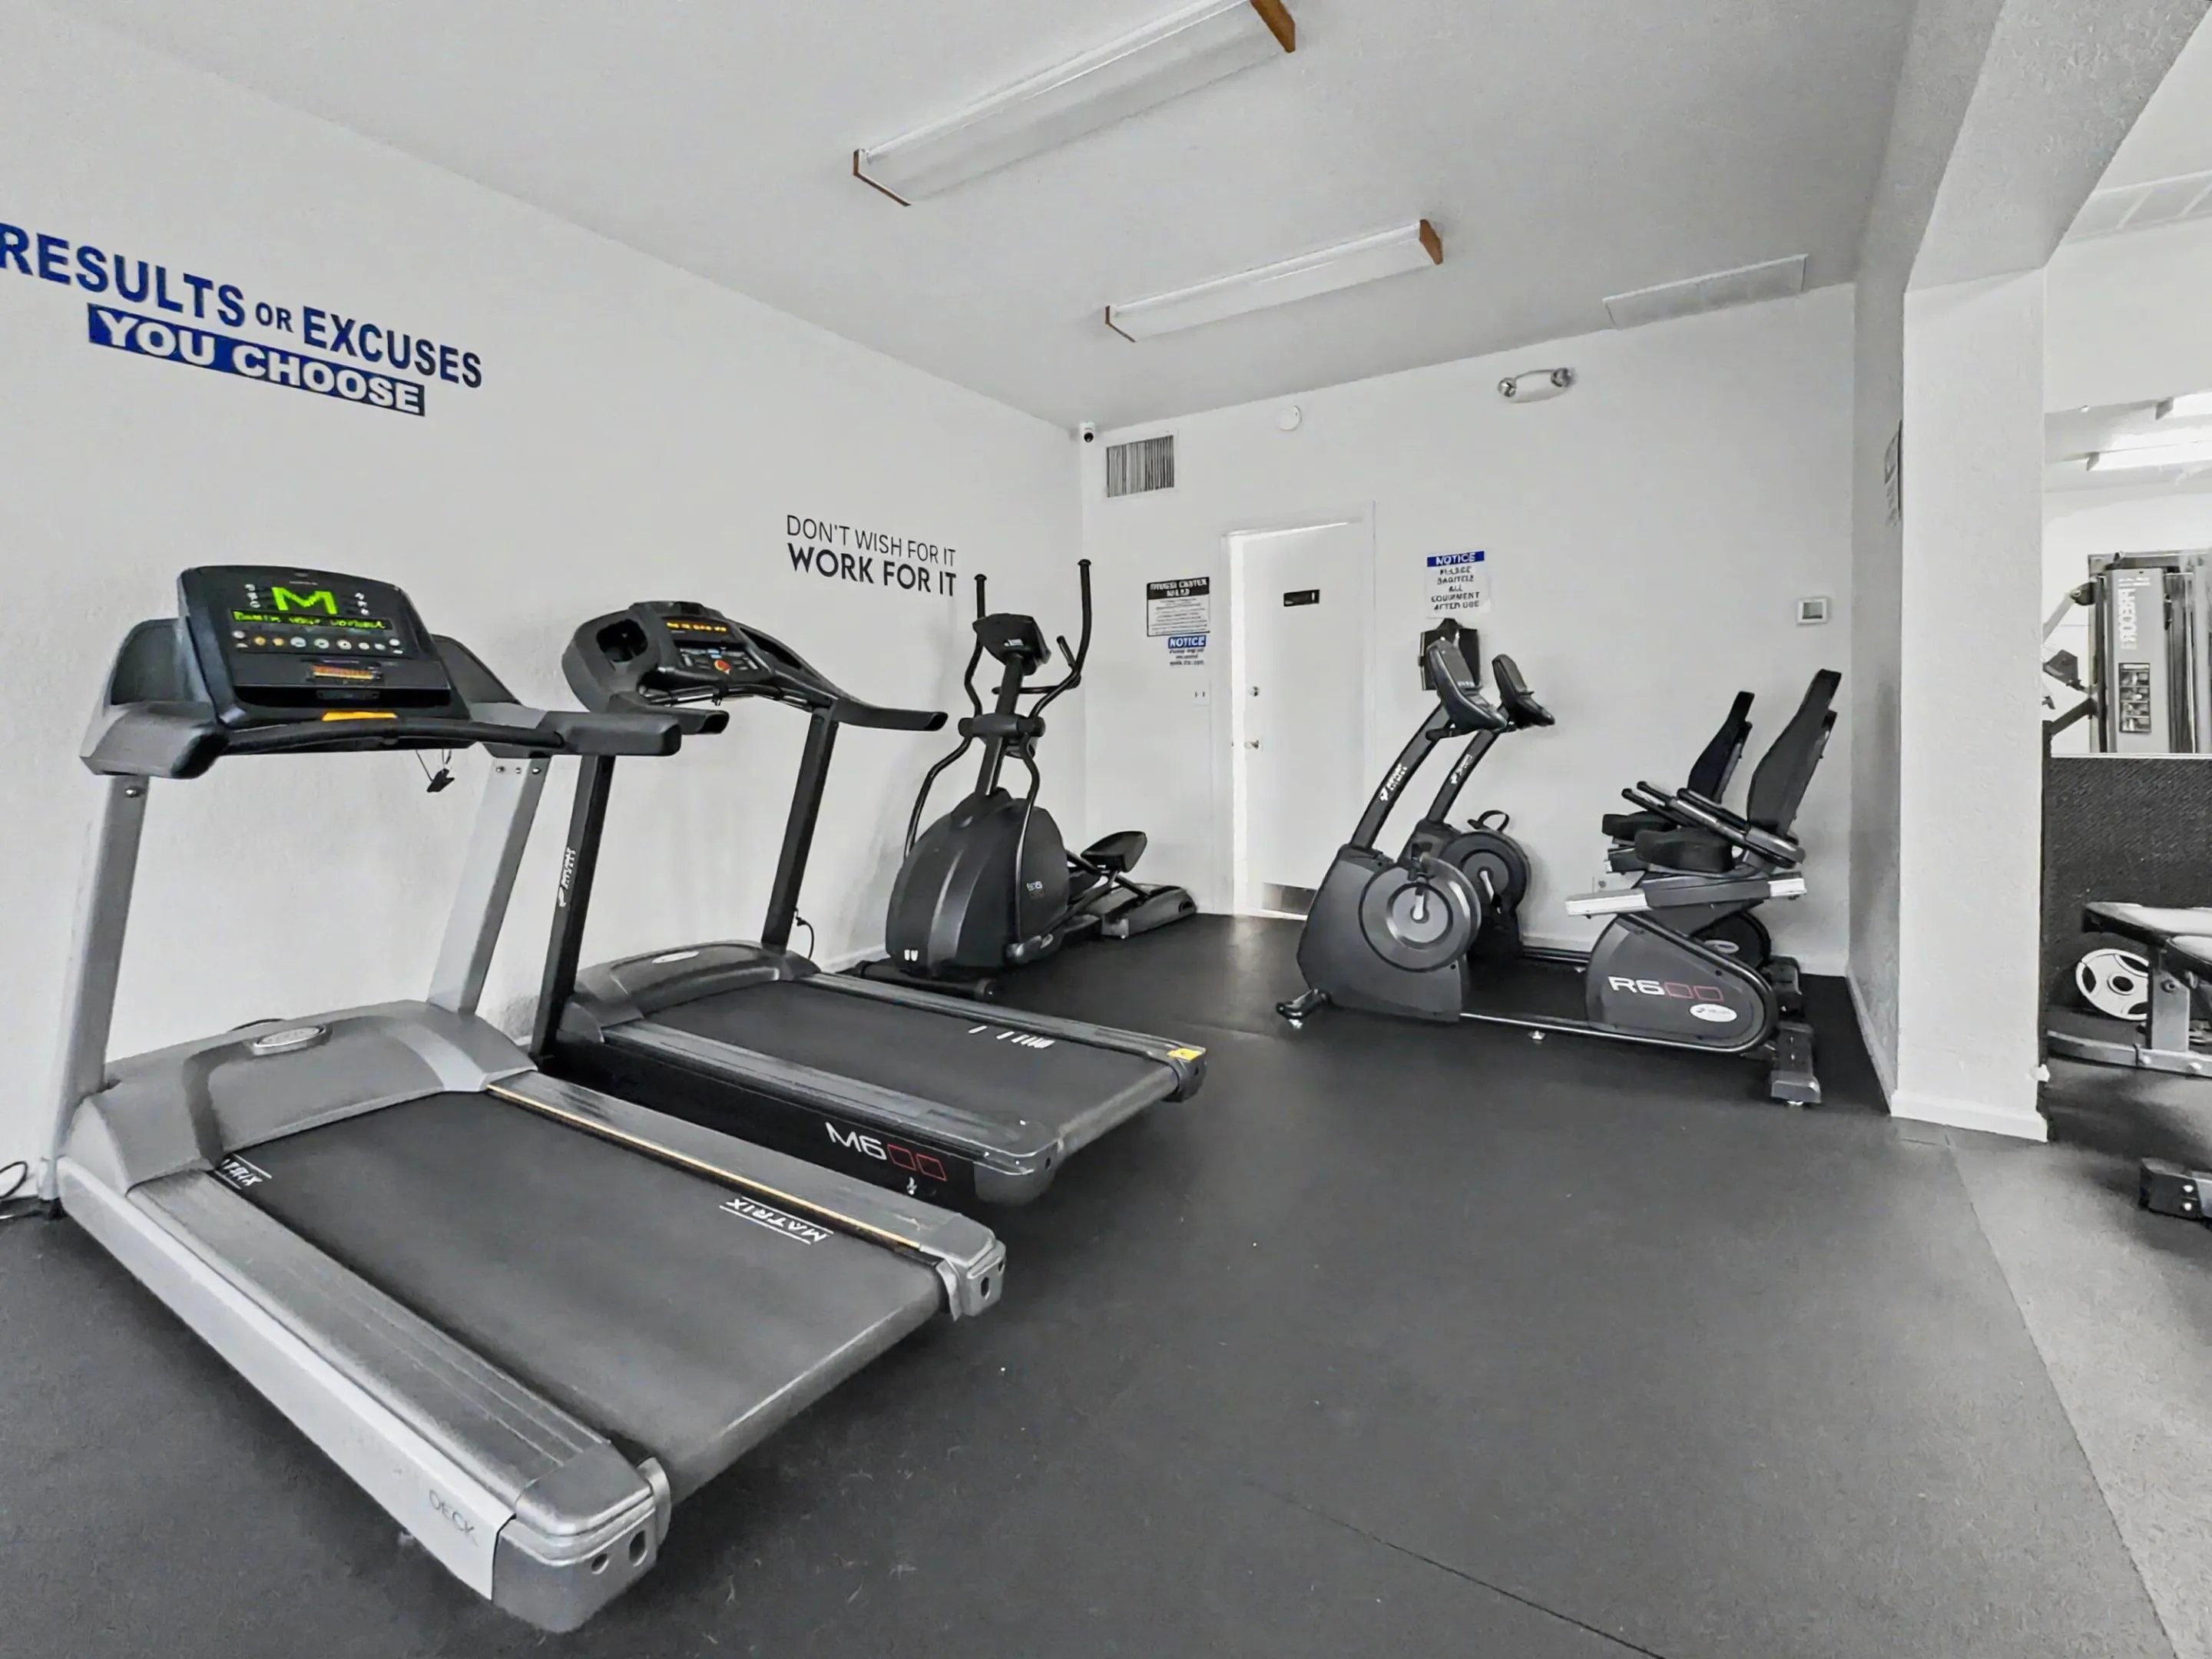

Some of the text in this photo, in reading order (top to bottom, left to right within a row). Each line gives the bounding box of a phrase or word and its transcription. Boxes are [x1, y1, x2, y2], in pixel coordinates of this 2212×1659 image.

[0, 223, 482, 388] RESULTS OR EXCUSES
[97, 310, 420, 413] YOU CHOOSE
[787, 515, 956, 567] DON'T WISH FOR IT
[1435, 552, 1475, 565] NOTICE
[787, 542, 957, 597] WORK FOR IT
[1170, 636, 1205, 647] NOTICE
[726, 1198, 828, 1243] MATRIX
